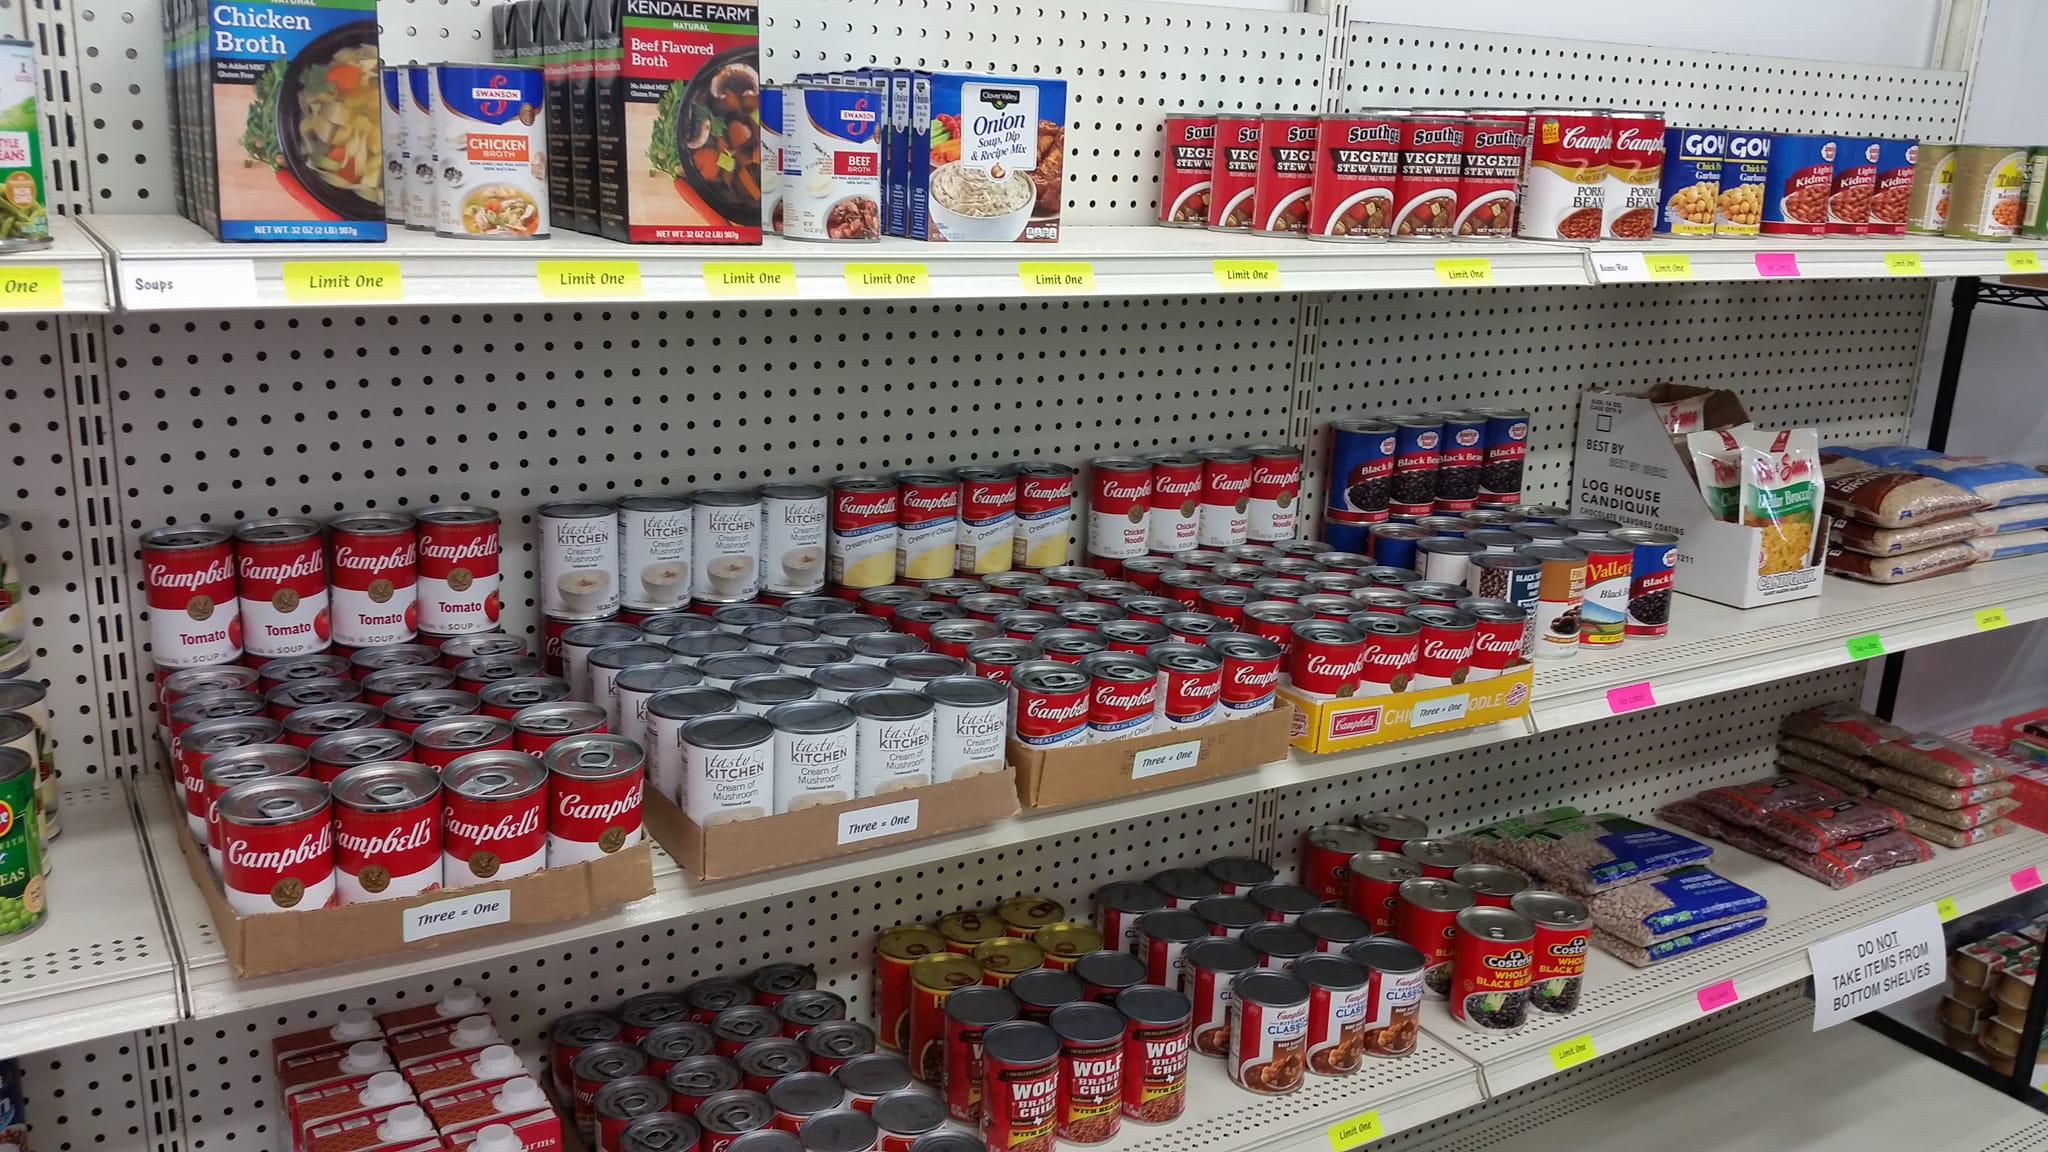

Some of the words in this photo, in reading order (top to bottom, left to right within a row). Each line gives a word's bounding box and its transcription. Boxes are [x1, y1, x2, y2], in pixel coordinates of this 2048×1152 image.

[628, 0, 703, 18] KENDALE
[213, 5, 312, 31] Chicken
[673, 22, 709, 31] NATURAL
[215, 30, 287, 55] Broth
[631, 38, 659, 52] Beef
[662, 41, 714, 56] Flavored
[632, 54, 668, 67] Broth
[476, 90, 518, 99] SWANSON
[973, 112, 1026, 136] Onion
[470, 139, 527, 150] CHICKEN
[978, 137, 1003, 149] Soup,
[1005, 131, 1021, 144] Dip
[0, 150, 25, 161] EANS
[970, 151, 979, 161] &
[980, 148, 1009, 162] Recipe
[1010, 144, 1027, 154] Mix
[848, 156, 871, 166] BEEF
[1337, 165, 1369, 173] STEW
[1402, 166, 1432, 174] STEW
[560, 273, 596, 285] Limit
[600, 273, 625, 285] One
[723, 273, 755, 284] Limit
[759, 272, 781, 284] One
[863, 274, 892, 285] Limit
[896, 274, 916, 285] One
[1036, 274, 1061, 285] Limit
[1065, 274, 1082, 285] One
[1227, 270, 1251, 280] Limit
[1253, 270, 1268, 280] One
[1448, 270, 1468, 279] Limit
[1469, 270, 1484, 279] One
[5, 280, 38, 293] One
[135, 278, 174, 292] Soups
[309, 275, 350, 289] Limit
[356, 274, 384, 288] One
[1489, 448, 1516, 458] Black
[1586, 439, 1609, 453] BEST
[1611, 443, 1624, 455] BY
[1398, 457, 1424, 467] Black
[1361, 465, 1387, 476] Black
[1582, 478, 1609, 492] LOG
[1614, 485, 1661, 503] HOUSE
[1581, 493, 1660, 518] CANDIQUIK
[1580, 507, 1617, 522] CHOCOLATE
[1619, 515, 1652, 530] FLAVORED
[1654, 522, 1685, 536] COATING
[644, 519, 689, 537] KITCHEN
[558, 526, 608, 545] KITCHEN
[908, 533, 930, 545] Cream
[1124, 535, 1144, 544] Noodle
[845, 539, 867, 551] Cream
[567, 547, 592, 556] Cream
[565, 554, 603, 563] Mushroom
[1643, 575, 1668, 588] Black
[1600, 589, 1624, 598] Black
[439, 601, 481, 613] Tomato
[358, 613, 402, 625] Tomato
[265, 622, 311, 637] Tomato
[180, 630, 226, 646] Tomato
[368, 635, 394, 643] SOUP
[277, 645, 304, 654] SOUP
[192, 653, 219, 663] SOUP
[1419, 707, 1440, 717] Three
[1447, 702, 1462, 712] One
[957, 714, 1003, 735] KITCHEN
[1181, 713, 1203, 724] GREAT
[1096, 723, 1121, 732] GREAT
[880, 728, 929, 749] KITCHEN
[966, 738, 991, 747] Cream
[1029, 734, 1054, 745] GREAT
[791, 741, 847, 763] KITCHEN
[963, 744, 999, 755] Mushroom
[889, 752, 916, 761] Cream
[917, 751, 924, 759] of
[1142, 756, 1166, 768] Three
[1176, 750, 1192, 761] One
[706, 757, 764, 779] KITCHEN
[886, 758, 924, 770] Mushroom
[801, 767, 829, 776] Cream
[831, 765, 838, 773] of
[799, 774, 841, 785] Mushroom
[716, 781, 746, 792] Cream
[748, 780, 755, 789] of
[713, 788, 758, 801] Mushroom
[849, 821, 877, 835] Three
[891, 814, 910, 826] One
[418, 909, 456, 926] Three
[473, 901, 499, 915] One
[1857, 941, 1874, 958] DO
[1876, 931, 1898, 951] NOT
[1510, 951, 1521, 959] La
[1539, 965, 1572, 974] BLACK
[1832, 968, 1861, 990] TAKE
[1864, 954, 1896, 978] ITEMS
[1899, 942, 1929, 964] FROM
[1495, 968, 1529, 979] WHOLE
[1476, 976, 1512, 988] BLACK
[1834, 982, 1880, 1011] BOTTOM
[1883, 962, 1930, 992] SHELVES
[1146, 1032, 1190, 1058] WOLF
[1559, 1047, 1575, 1060] Limit
[1576, 1043, 1587, 1054] One
[1073, 1053, 1123, 1077] WOLF
[1152, 1052, 1188, 1066] BRAND
[1153, 1060, 1187, 1076] CHILI
[1079, 1071, 1120, 1086] BRAND
[1013, 1071, 1059, 1100] WOLF
[1080, 1082, 1118, 1096] CHILI
[1146, 1086, 1170, 1095] WITH
[1019, 1090, 1057, 1108] BRAND
[1020, 1102, 1056, 1118] CHILI
[1073, 1105, 1098, 1114] WITH
[1339, 1126, 1357, 1140] Limit
[1359, 1120, 1372, 1133] One
